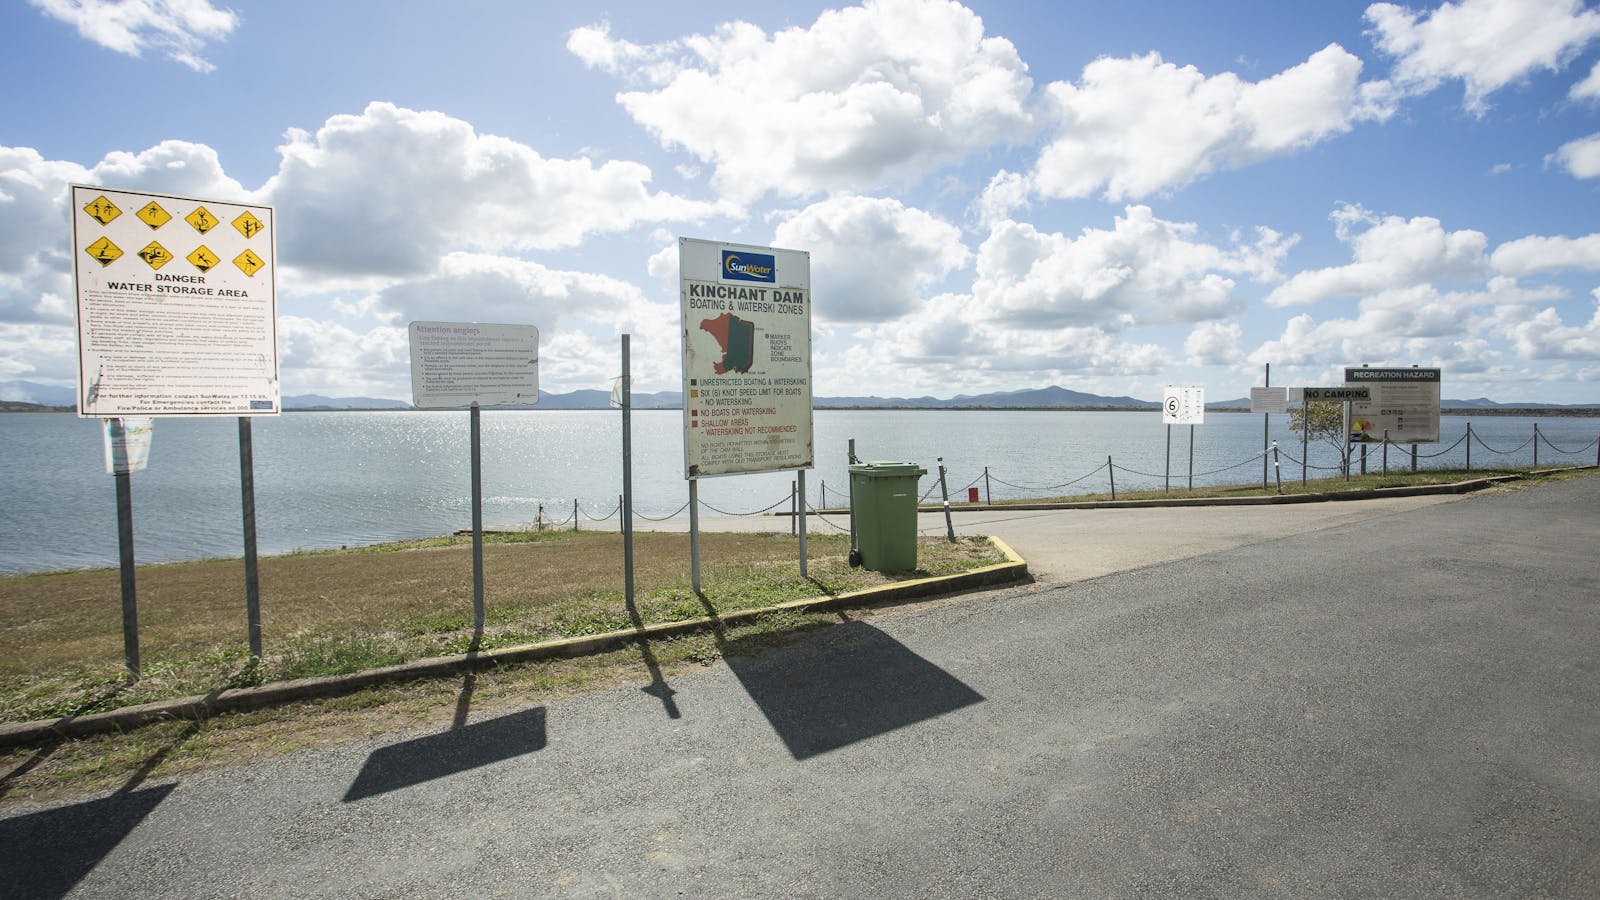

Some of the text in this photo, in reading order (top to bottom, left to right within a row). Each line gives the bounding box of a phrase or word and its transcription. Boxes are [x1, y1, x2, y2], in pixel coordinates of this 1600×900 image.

[730, 262, 772, 274] SunWater
[155, 273, 206, 284] DANGER
[107, 281, 249, 298] WATER STORAGE AREA
[690, 284, 803, 304] KINCHANT DAM
[690, 298, 804, 315] BOATING & WATERSKI ZONES
[416, 325, 451, 333] Attention
[1353, 371, 1434, 379] RECREATION HAZARD
[700, 378, 743, 386] UNRESTRICTED
[743, 378, 767, 386] BOATING
[700, 389, 710, 397] SIX
[722, 388, 738, 397] KNOT
[739, 388, 757, 396] SPEED
[758, 388, 771, 396] LIMIT
[773, 388, 784, 396] FOR
[785, 387, 802, 396] BOATS
[1305, 390, 1369, 399] NO CAMPING
[705, 398, 714, 406] NO
[1168, 400, 1176, 411] 6
[700, 409, 710, 417] NO
[711, 409, 730, 417] BOATS
[731, 408, 740, 416] OR
[701, 418, 749, 428] SHALLOW AREAS
[744, 427, 756, 435] NOT
[757, 425, 797, 434] RECOMMENDED
